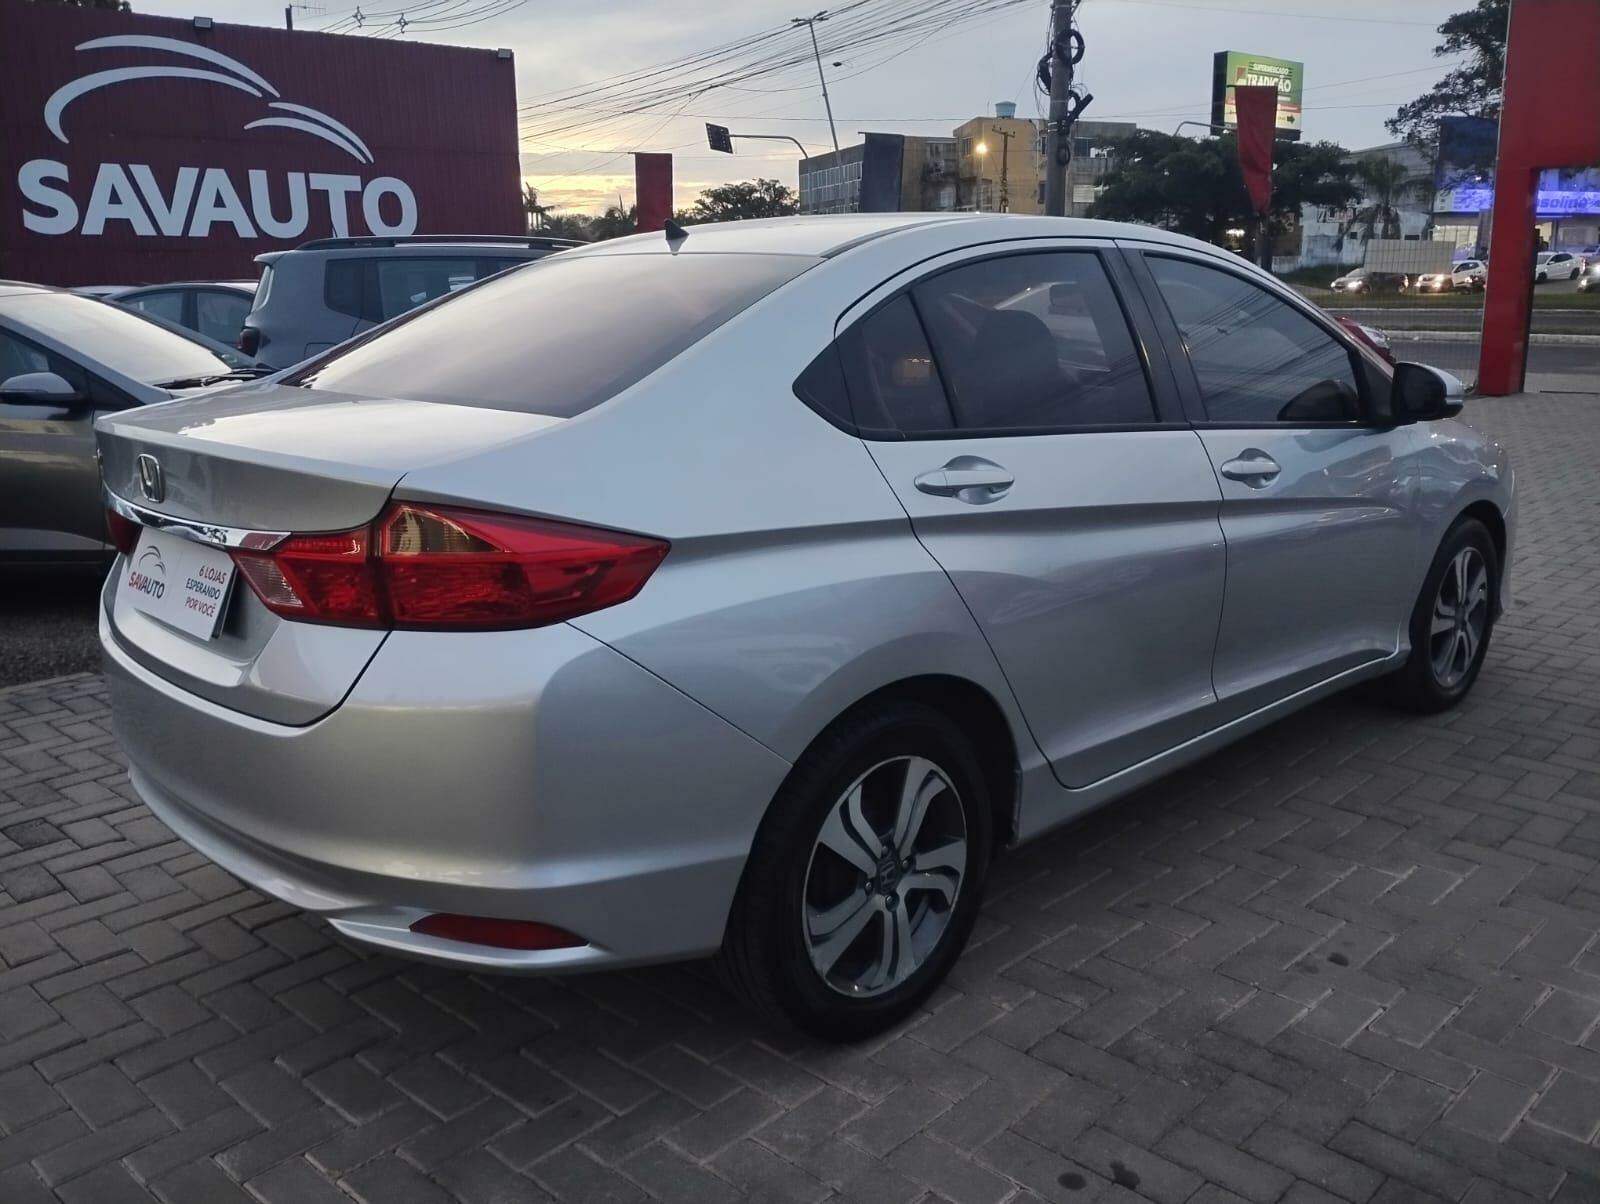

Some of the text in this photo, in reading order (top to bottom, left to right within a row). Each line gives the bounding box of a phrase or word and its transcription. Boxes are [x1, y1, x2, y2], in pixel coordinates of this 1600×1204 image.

[17, 158, 419, 239] SAVAUTO
[128, 571, 165, 599] SAVAUTO
[204, 567, 227, 584] LOJAS
[186, 577, 221, 600] ESPERANDO
[185, 596, 217, 618] POR VOCÊ
